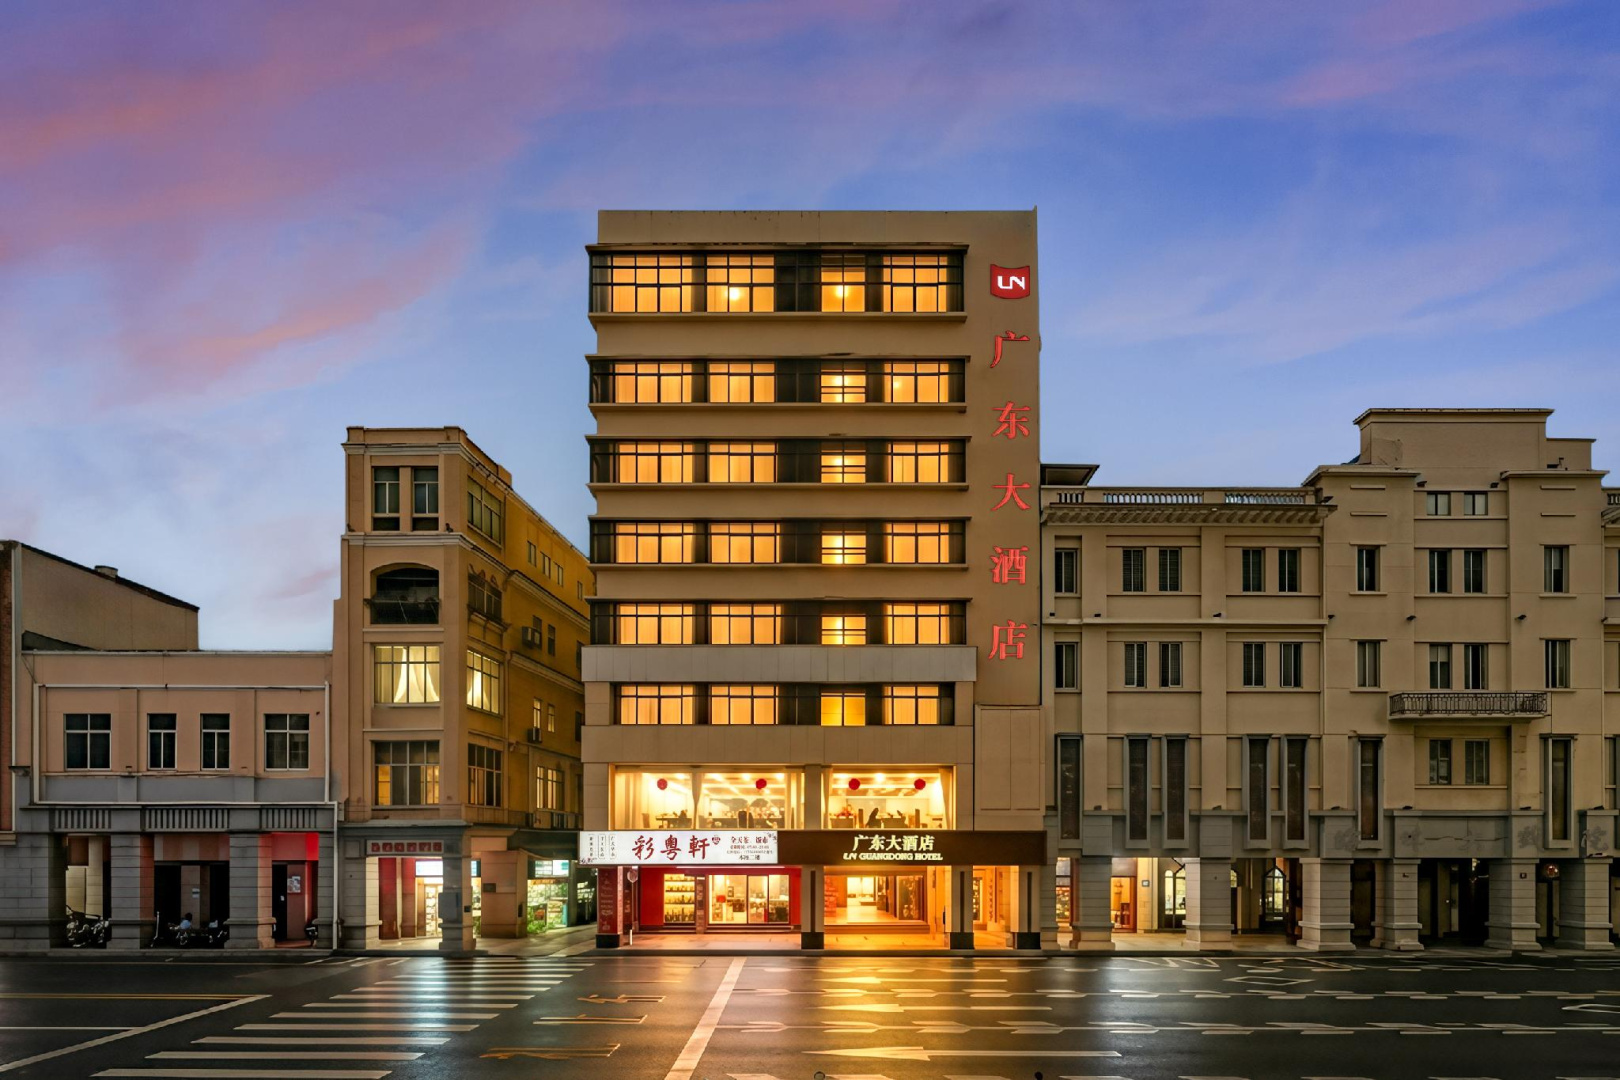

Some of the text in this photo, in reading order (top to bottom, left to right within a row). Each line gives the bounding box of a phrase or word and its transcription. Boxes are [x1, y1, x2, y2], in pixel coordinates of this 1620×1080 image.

[988, 330, 1031, 662] 广东大酒店
[852, 834, 935, 851] 广东大酒店
[858, 852, 914, 861] GUANGDONG
[914, 852, 943, 861] HOTEL
